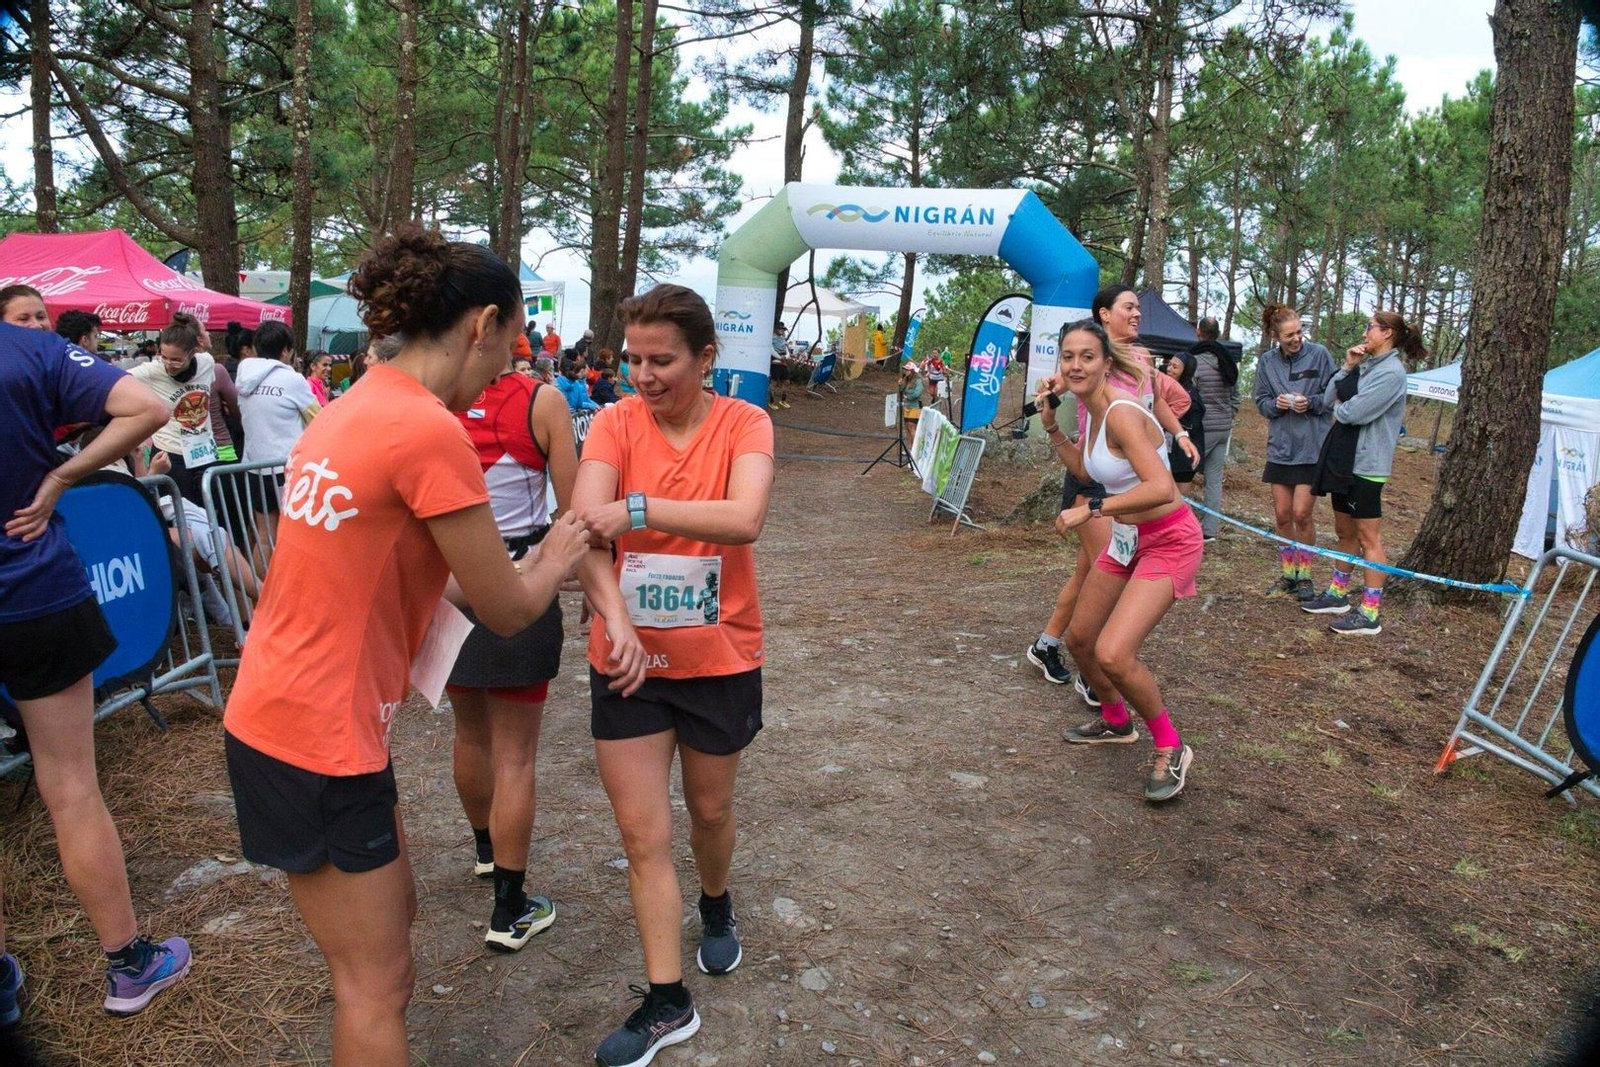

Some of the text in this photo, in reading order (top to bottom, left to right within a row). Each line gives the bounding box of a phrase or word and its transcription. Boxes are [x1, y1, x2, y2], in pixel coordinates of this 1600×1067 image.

[895, 203, 995, 225] NIGRÁN
[93, 301, 151, 323] Coca-Cola
[635, 584, 696, 612] 1364
